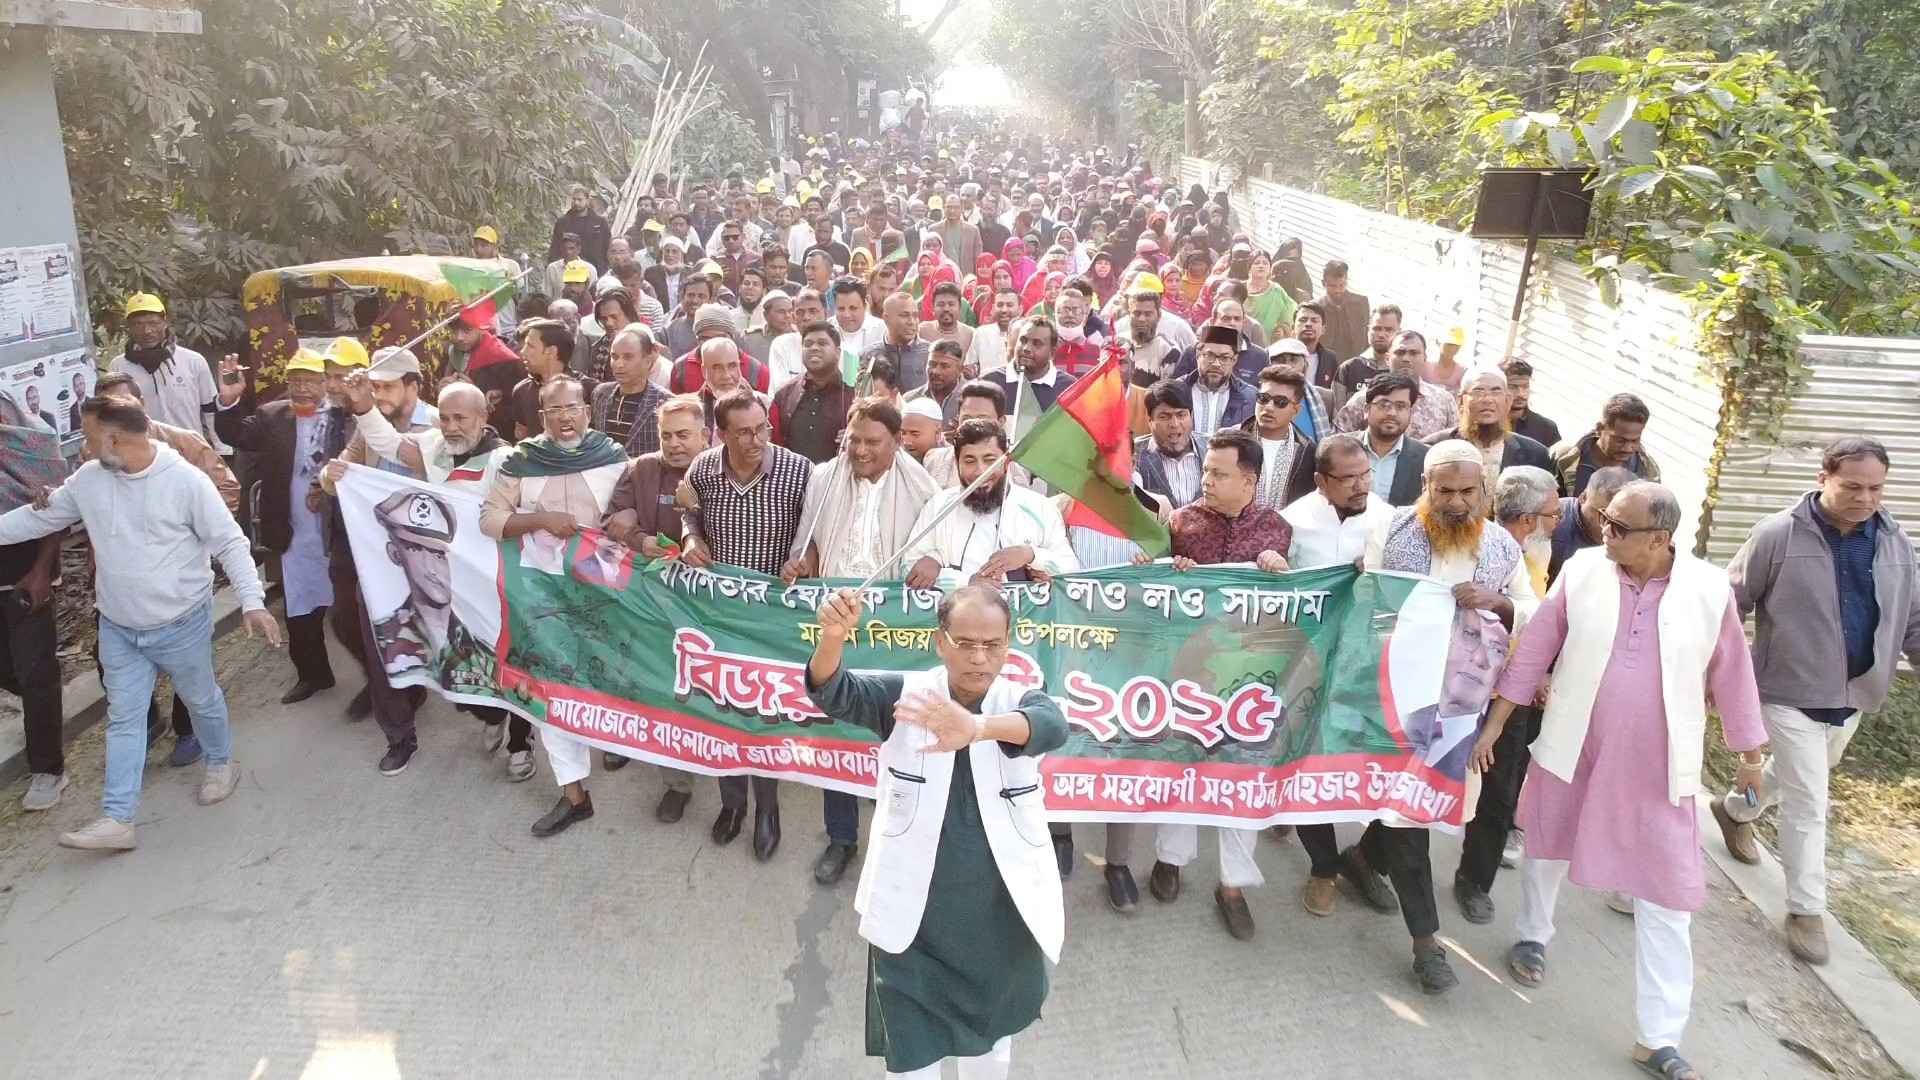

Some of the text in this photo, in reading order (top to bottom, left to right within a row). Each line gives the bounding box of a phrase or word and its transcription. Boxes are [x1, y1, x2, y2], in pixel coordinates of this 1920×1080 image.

[780, 581, 889, 615] ঘোক
[1063, 577, 1128, 612] লও
[1140, 582, 1205, 618] লও
[1217, 584, 1333, 624] সালাম
[864, 619, 940, 652] বিজয়
[1014, 616, 1120, 652] উপলক্ষে
[652, 719, 743, 764] বাংলাদেশ
[740, 737, 880, 779] জাতীয়তাবাদী
[1052, 773, 1097, 801] অঙ্গ
[1100, 767, 1197, 807] সহযোগী
